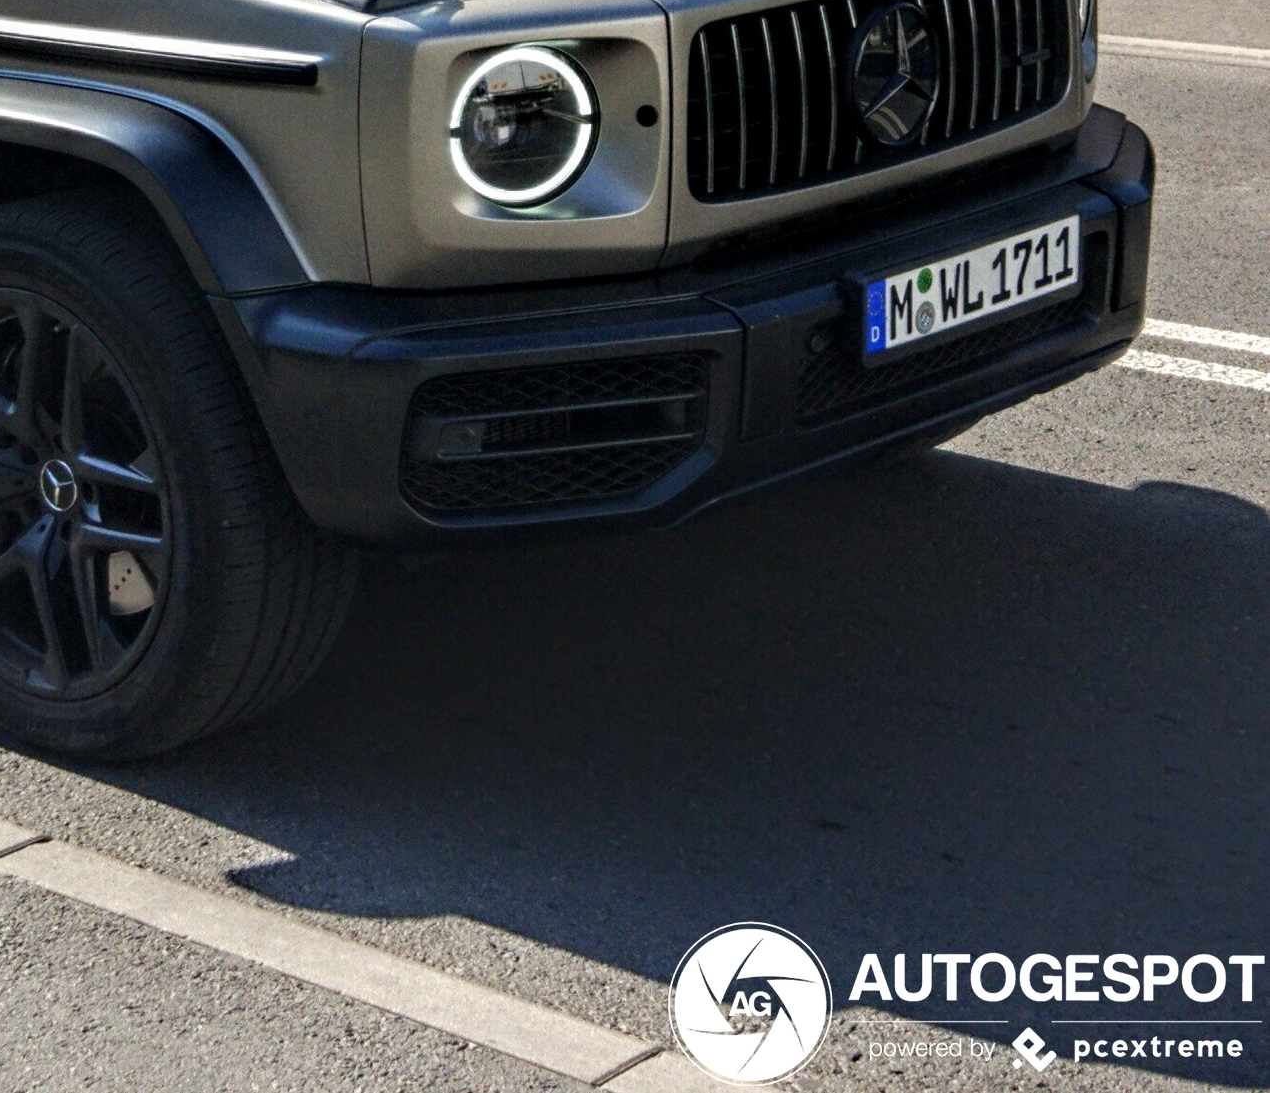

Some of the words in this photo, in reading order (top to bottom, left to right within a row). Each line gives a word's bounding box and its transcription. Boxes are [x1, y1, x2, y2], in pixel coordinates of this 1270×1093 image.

[890, 279, 913, 340] M
[940, 260, 983, 322] WL
[992, 226, 1073, 304] 1711
[871, 326, 880, 342] D
